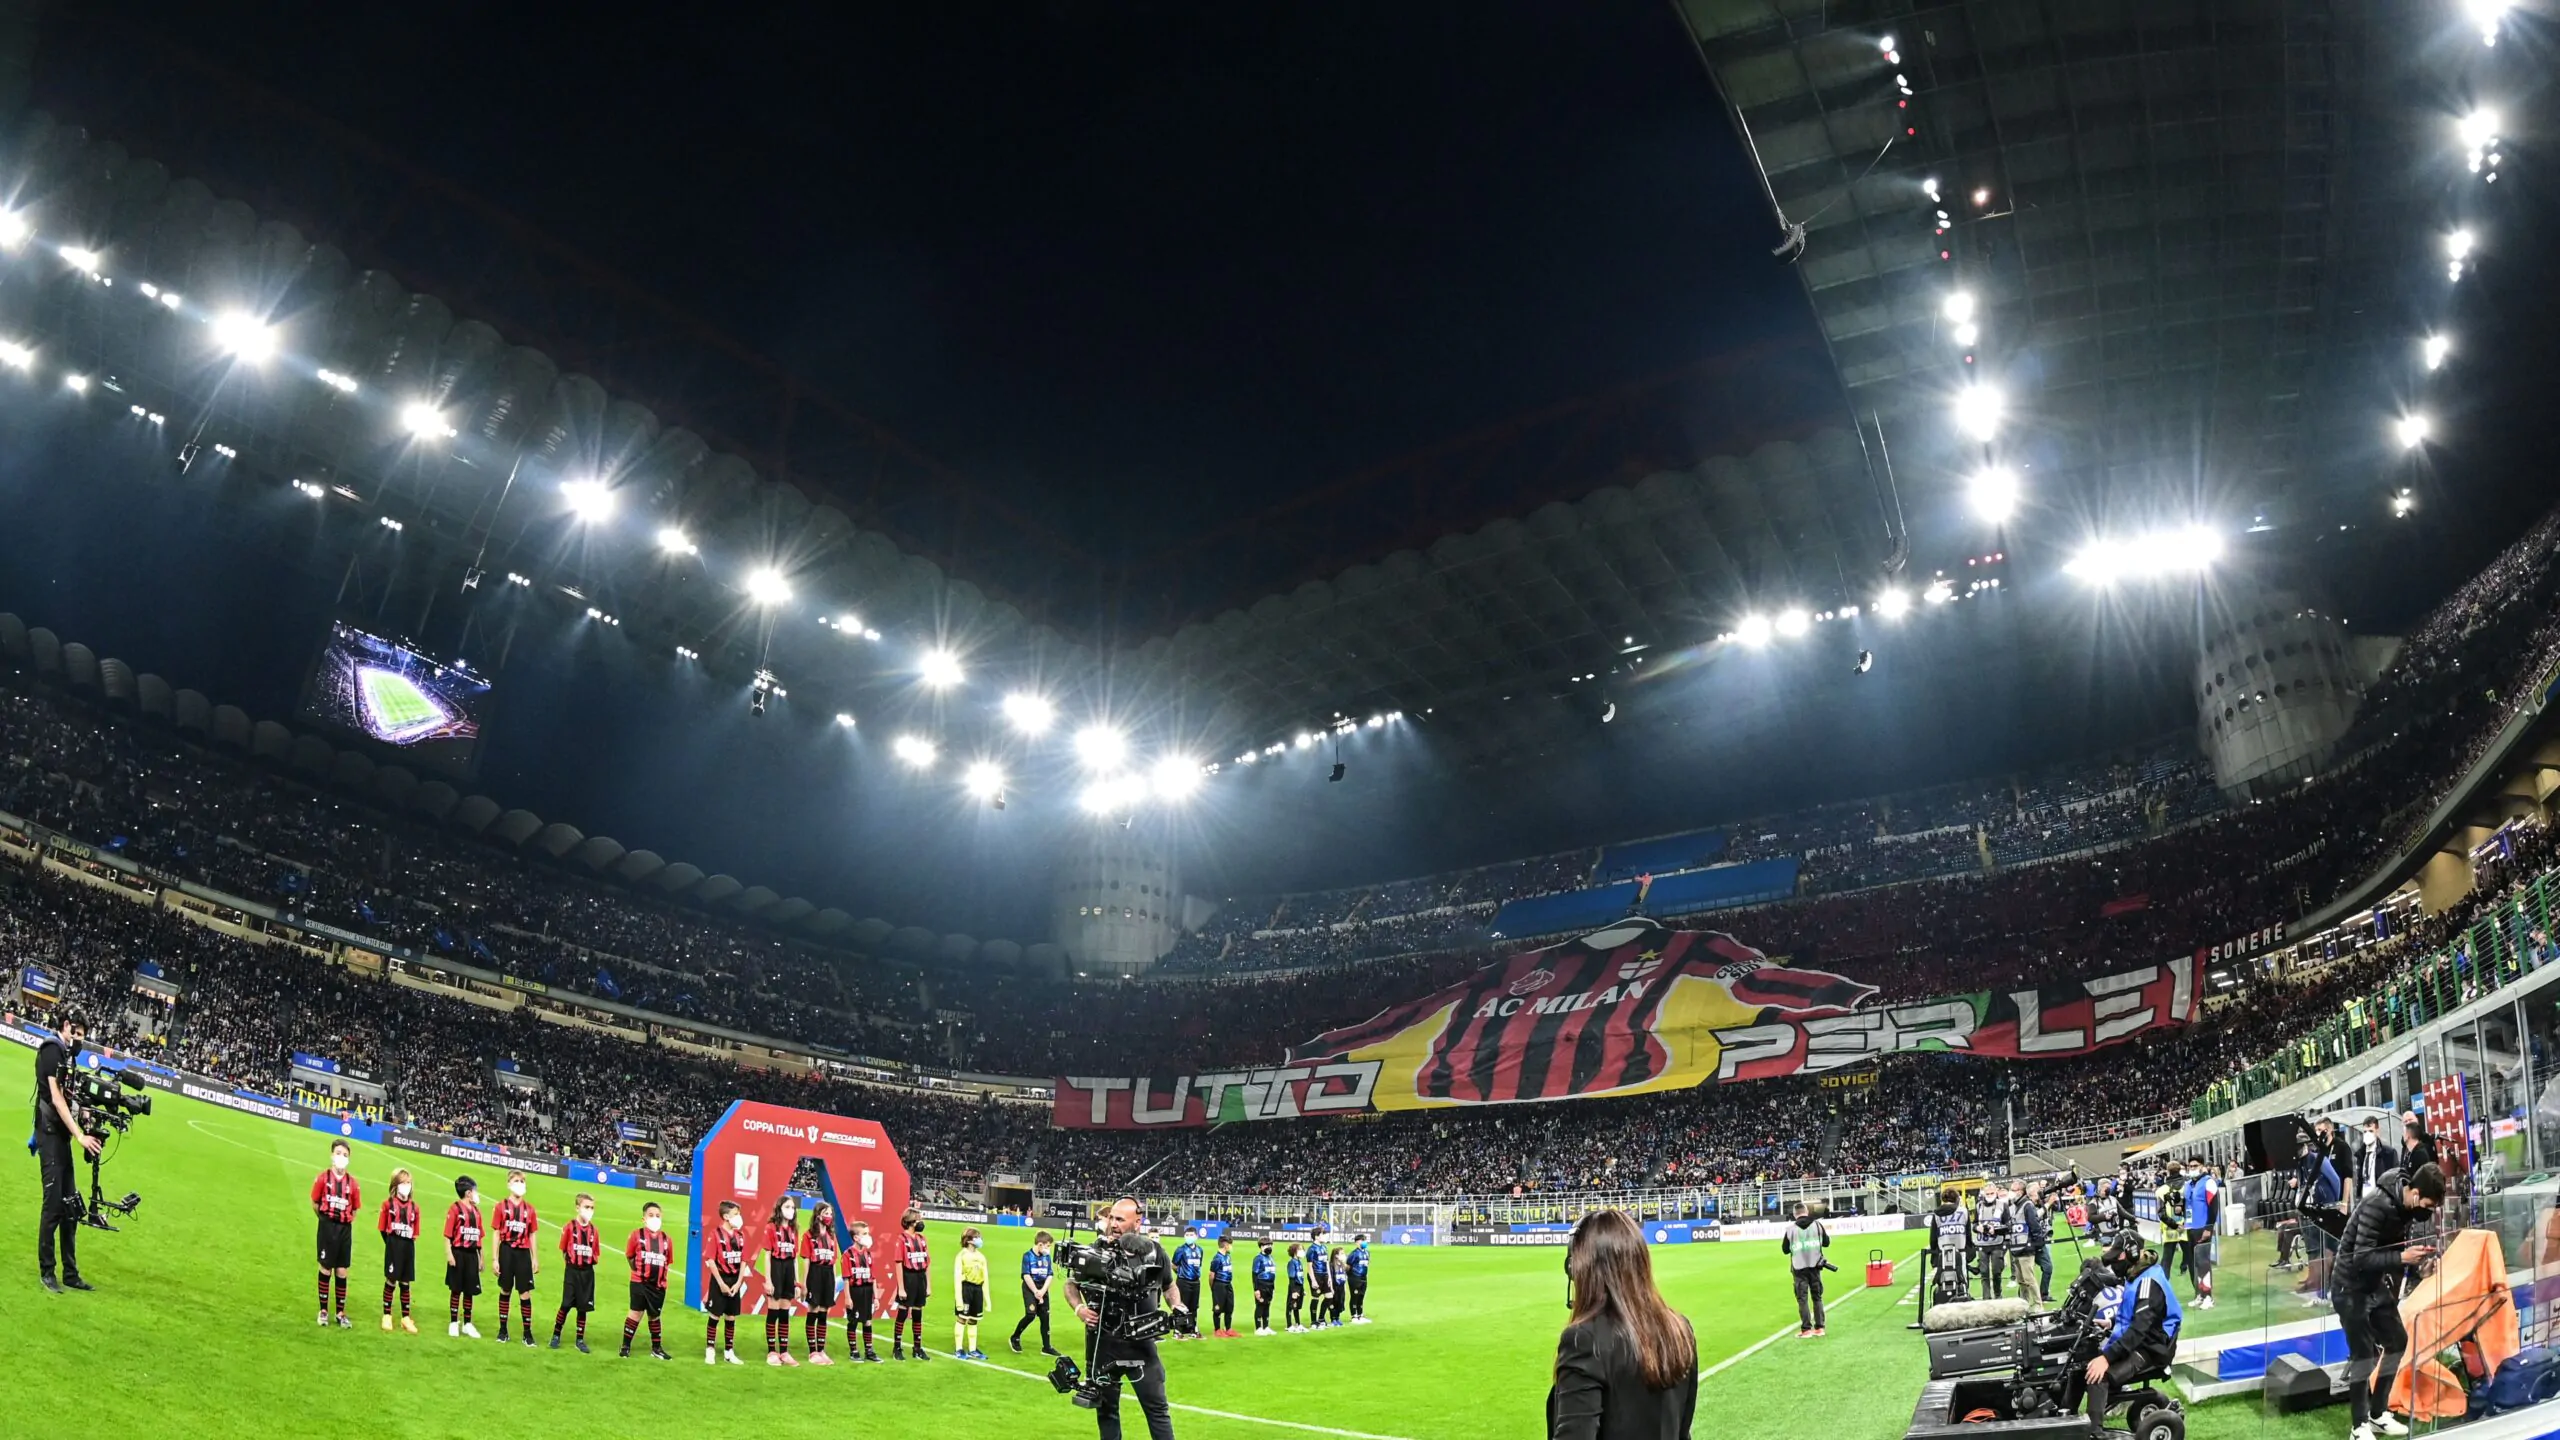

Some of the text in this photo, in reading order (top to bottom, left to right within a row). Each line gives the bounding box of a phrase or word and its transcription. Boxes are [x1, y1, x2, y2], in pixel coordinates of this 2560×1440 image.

[1472, 978, 1656, 1018] AC MILAN
[1709, 956, 2193, 1079] PER LEI
[1065, 1061, 1383, 1124] TUTTO
[743, 1119, 775, 1134] COPPA
[776, 1124, 805, 1138] ITALIA
[393, 1136, 431, 1150] SEGUICI SU
[646, 1181, 670, 1190] SEGUICI
[1692, 1228, 1720, 1239] 00:00
[1939, 1223, 1966, 1236] PHOTO
